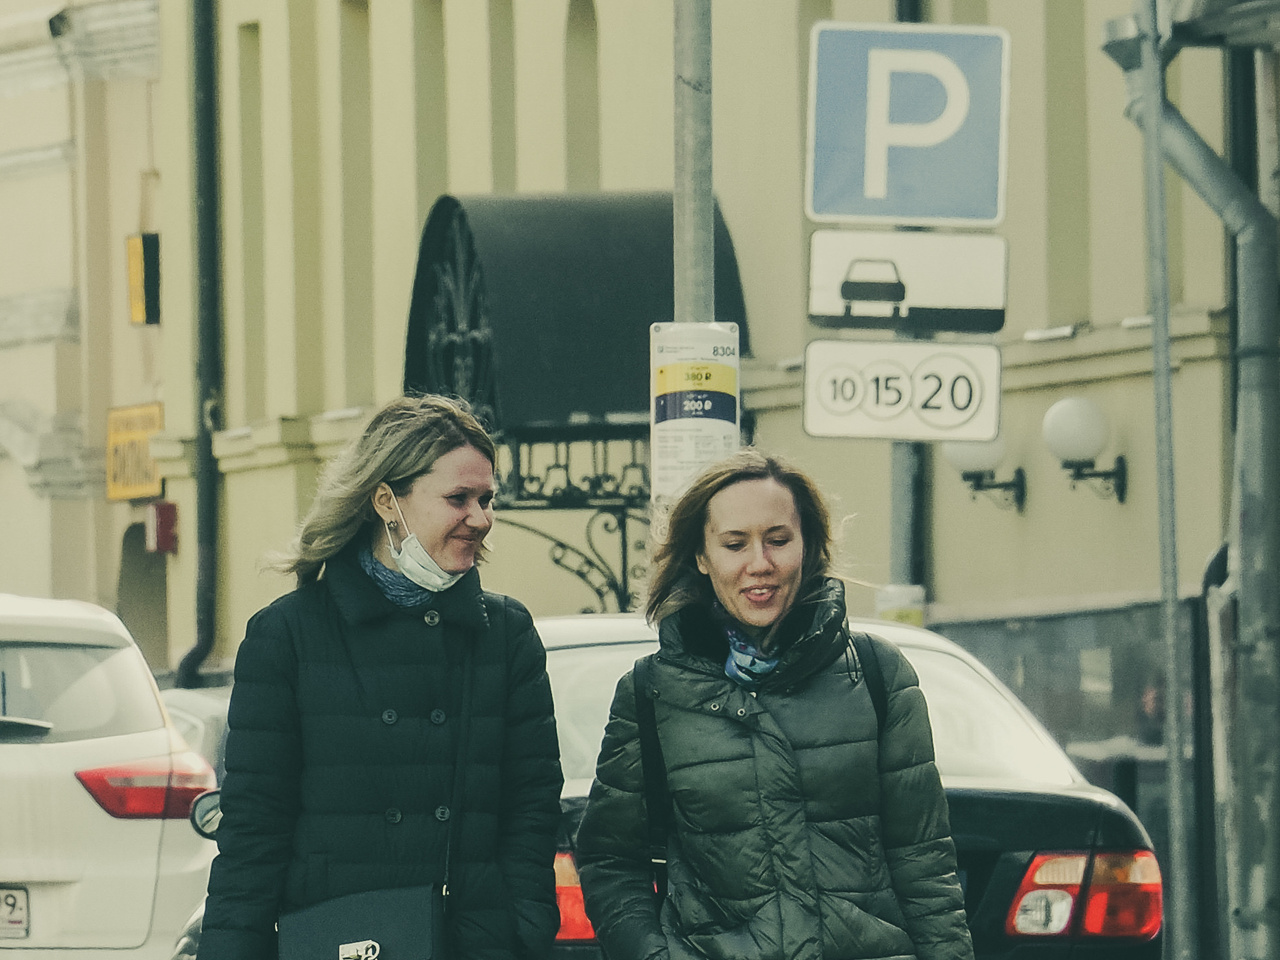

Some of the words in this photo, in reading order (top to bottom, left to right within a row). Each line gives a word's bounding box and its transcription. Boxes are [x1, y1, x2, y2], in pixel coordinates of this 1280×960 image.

[863, 48, 970, 199] P
[682, 400, 703, 411] 200
[830, 378, 856, 402] 10
[871, 376, 903, 406] 15
[921, 373, 973, 411] 20
